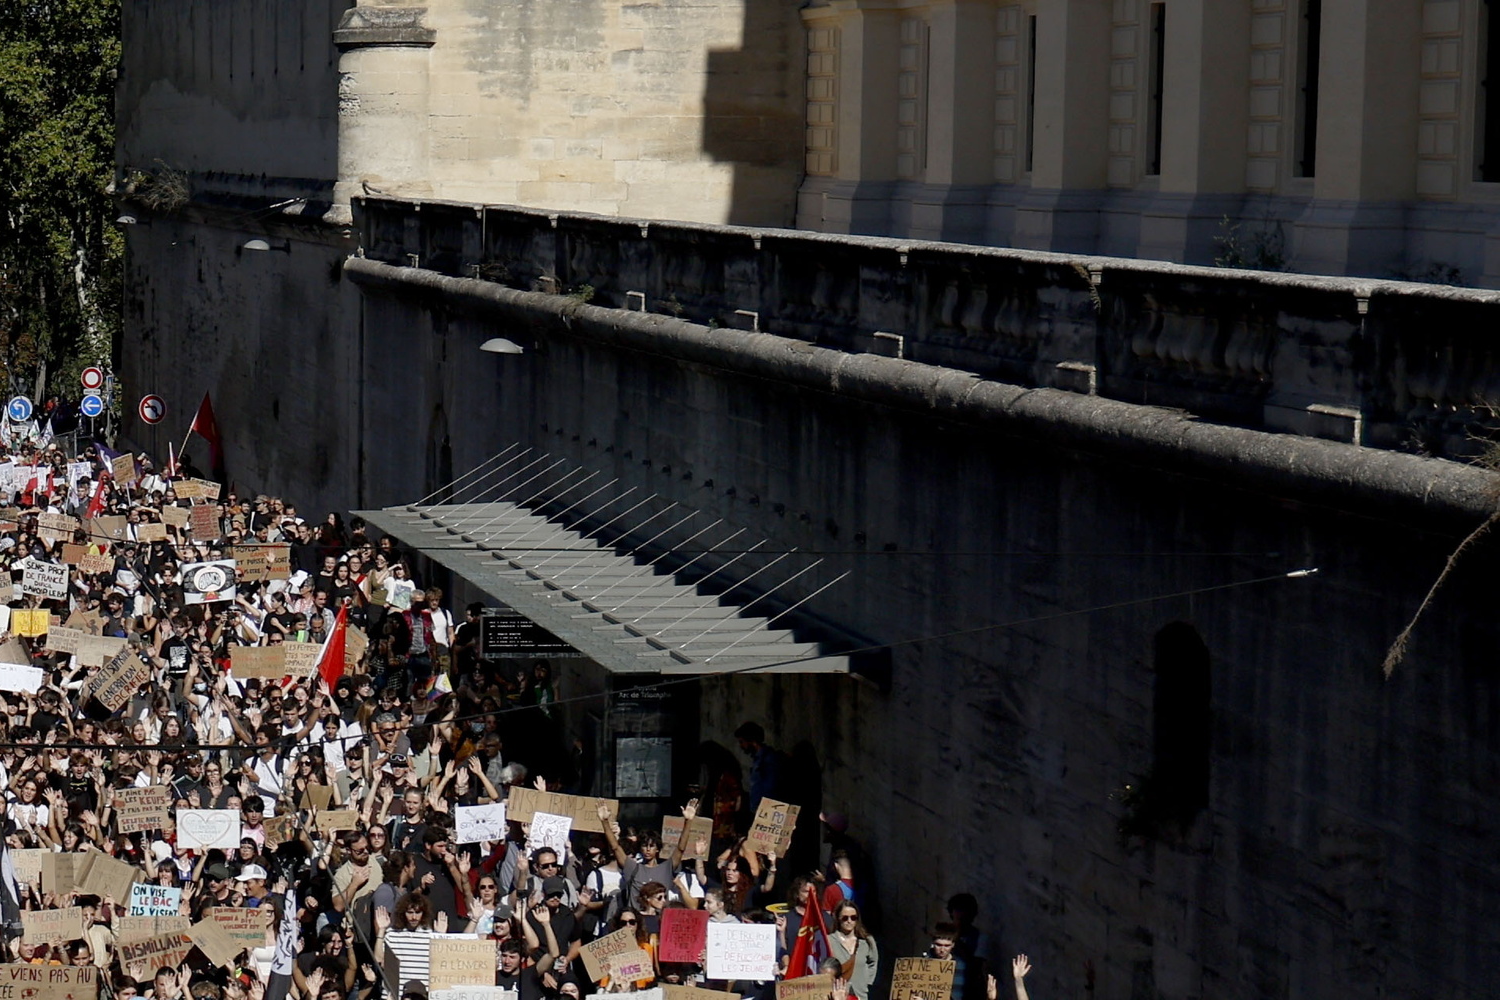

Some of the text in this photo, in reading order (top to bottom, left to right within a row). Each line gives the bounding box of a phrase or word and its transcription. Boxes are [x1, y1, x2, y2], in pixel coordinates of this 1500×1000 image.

[134, 886, 146, 896] ON
[140, 897, 172, 906] LE BAC
[939, 961, 954, 974] VA
[10, 965, 42, 982] VIENS
[49, 969, 70, 983] PAS
[77, 968, 91, 984] AU
[892, 990, 902, 1000] LE
